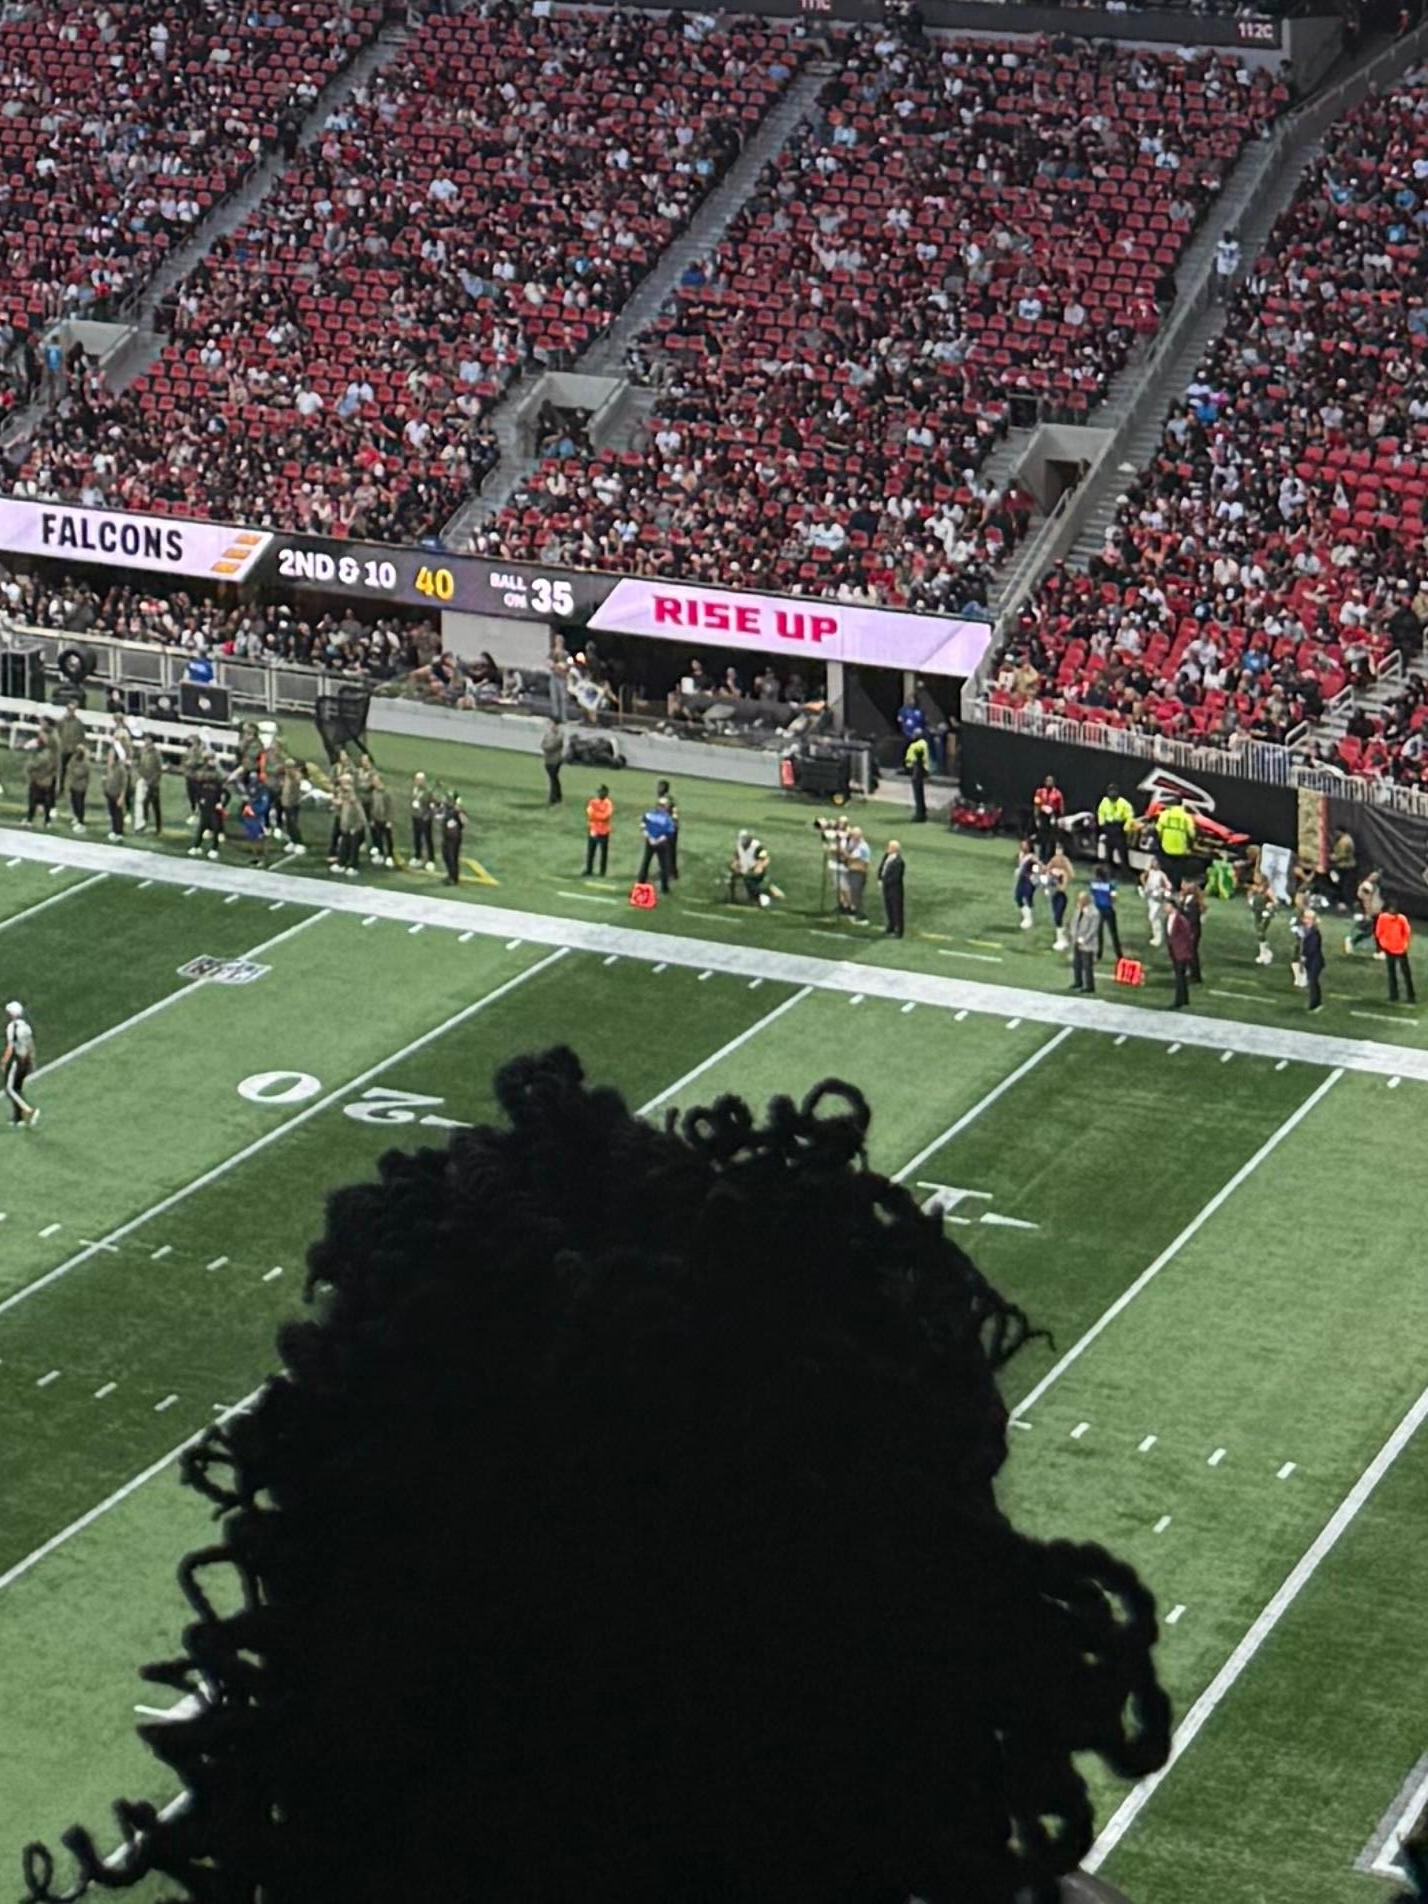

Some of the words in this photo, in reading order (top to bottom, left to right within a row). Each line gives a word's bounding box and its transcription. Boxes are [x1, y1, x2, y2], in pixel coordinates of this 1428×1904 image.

[42, 513, 183, 560] FALCONS
[279, 549, 333, 578] 2ND
[366, 561, 396, 589] 10
[415, 567, 453, 599] 40
[532, 579, 573, 615] 35
[653, 594, 761, 631] RISE
[776, 609, 838, 643] UP
